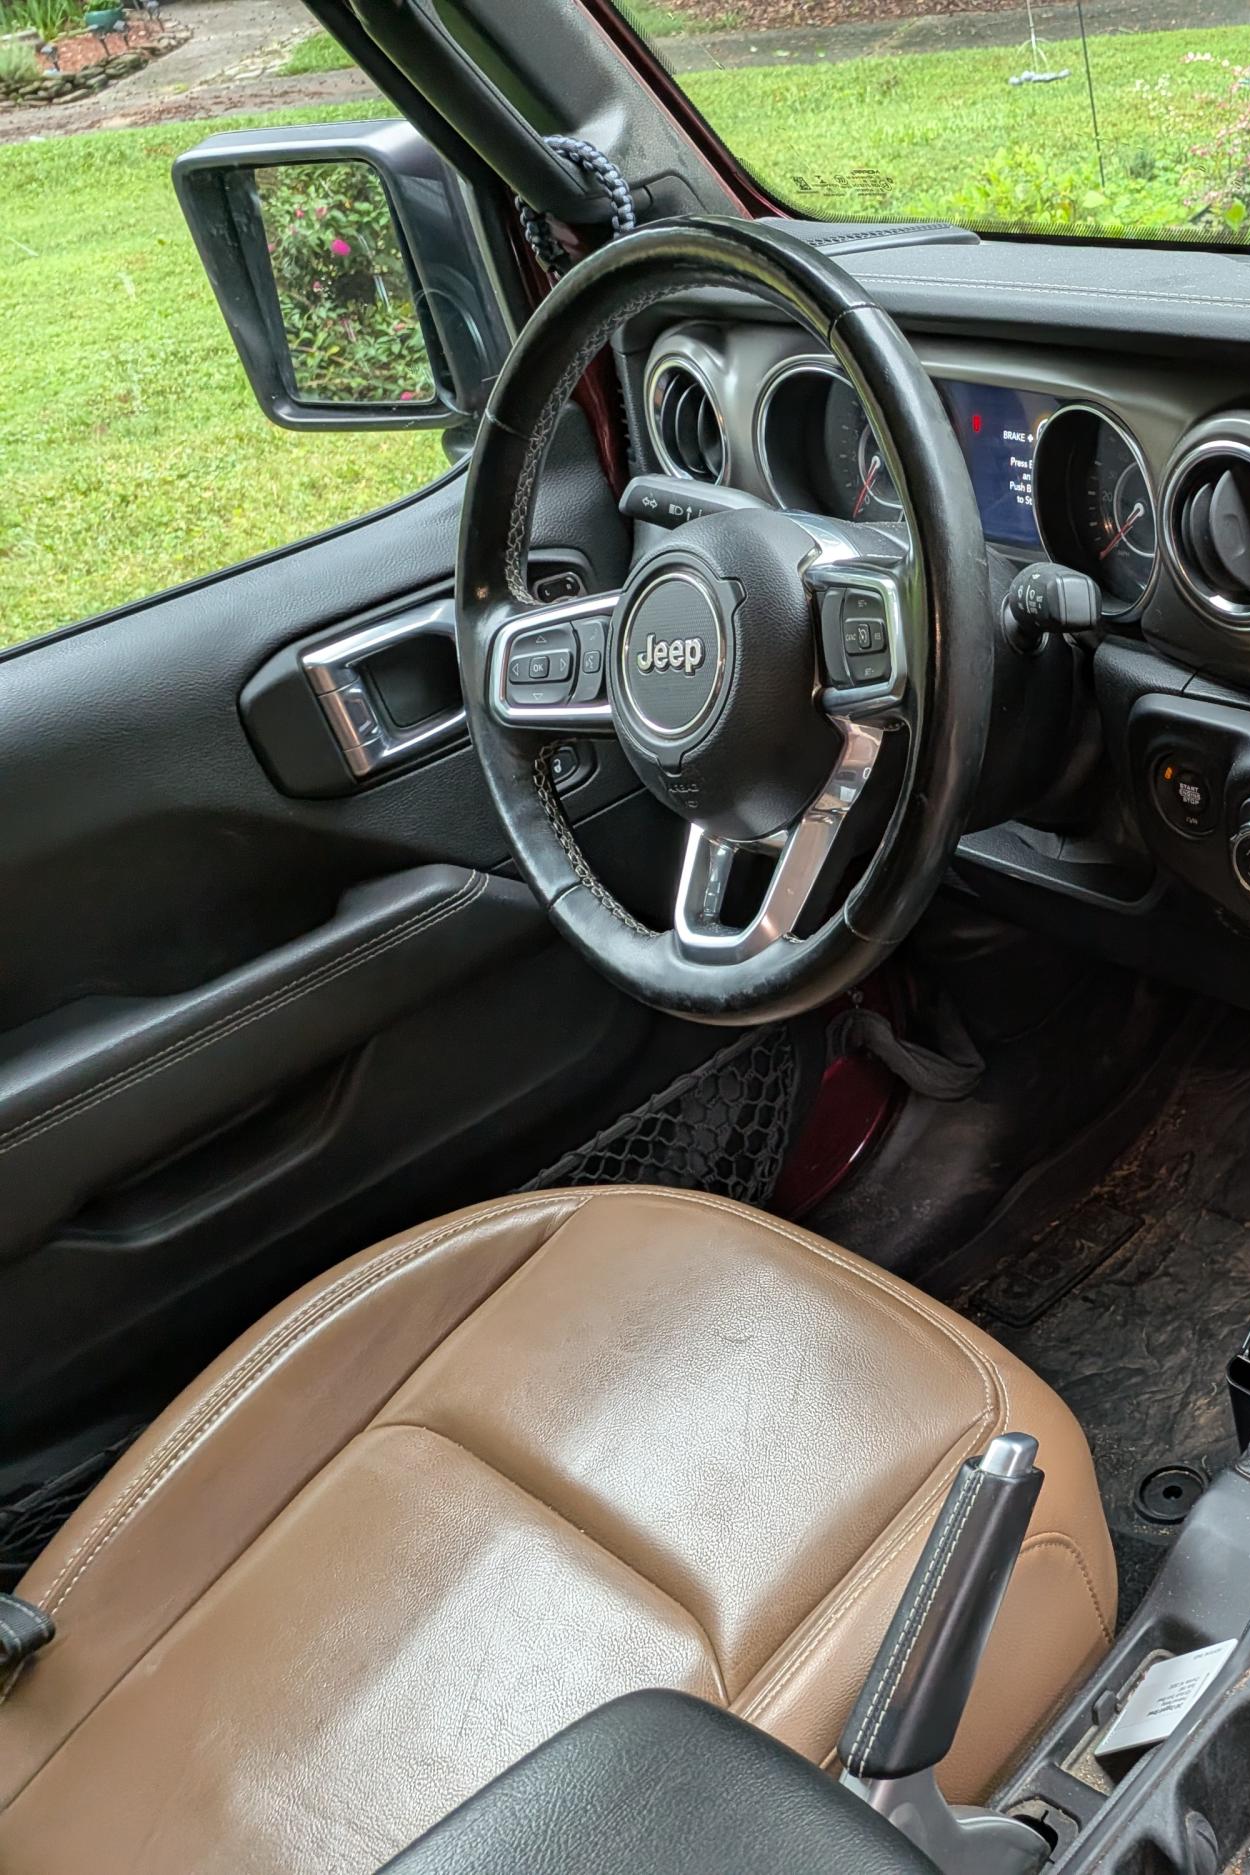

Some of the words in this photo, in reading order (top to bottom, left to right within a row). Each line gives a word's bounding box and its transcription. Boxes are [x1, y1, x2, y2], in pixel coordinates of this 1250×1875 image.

[1003, 430, 1026, 442] BRAKE
[1010, 456, 1028, 469] Press
[1009, 481, 1025, 492] Push
[637, 632, 703, 676] Jeep
[533, 662, 544, 673] OK
